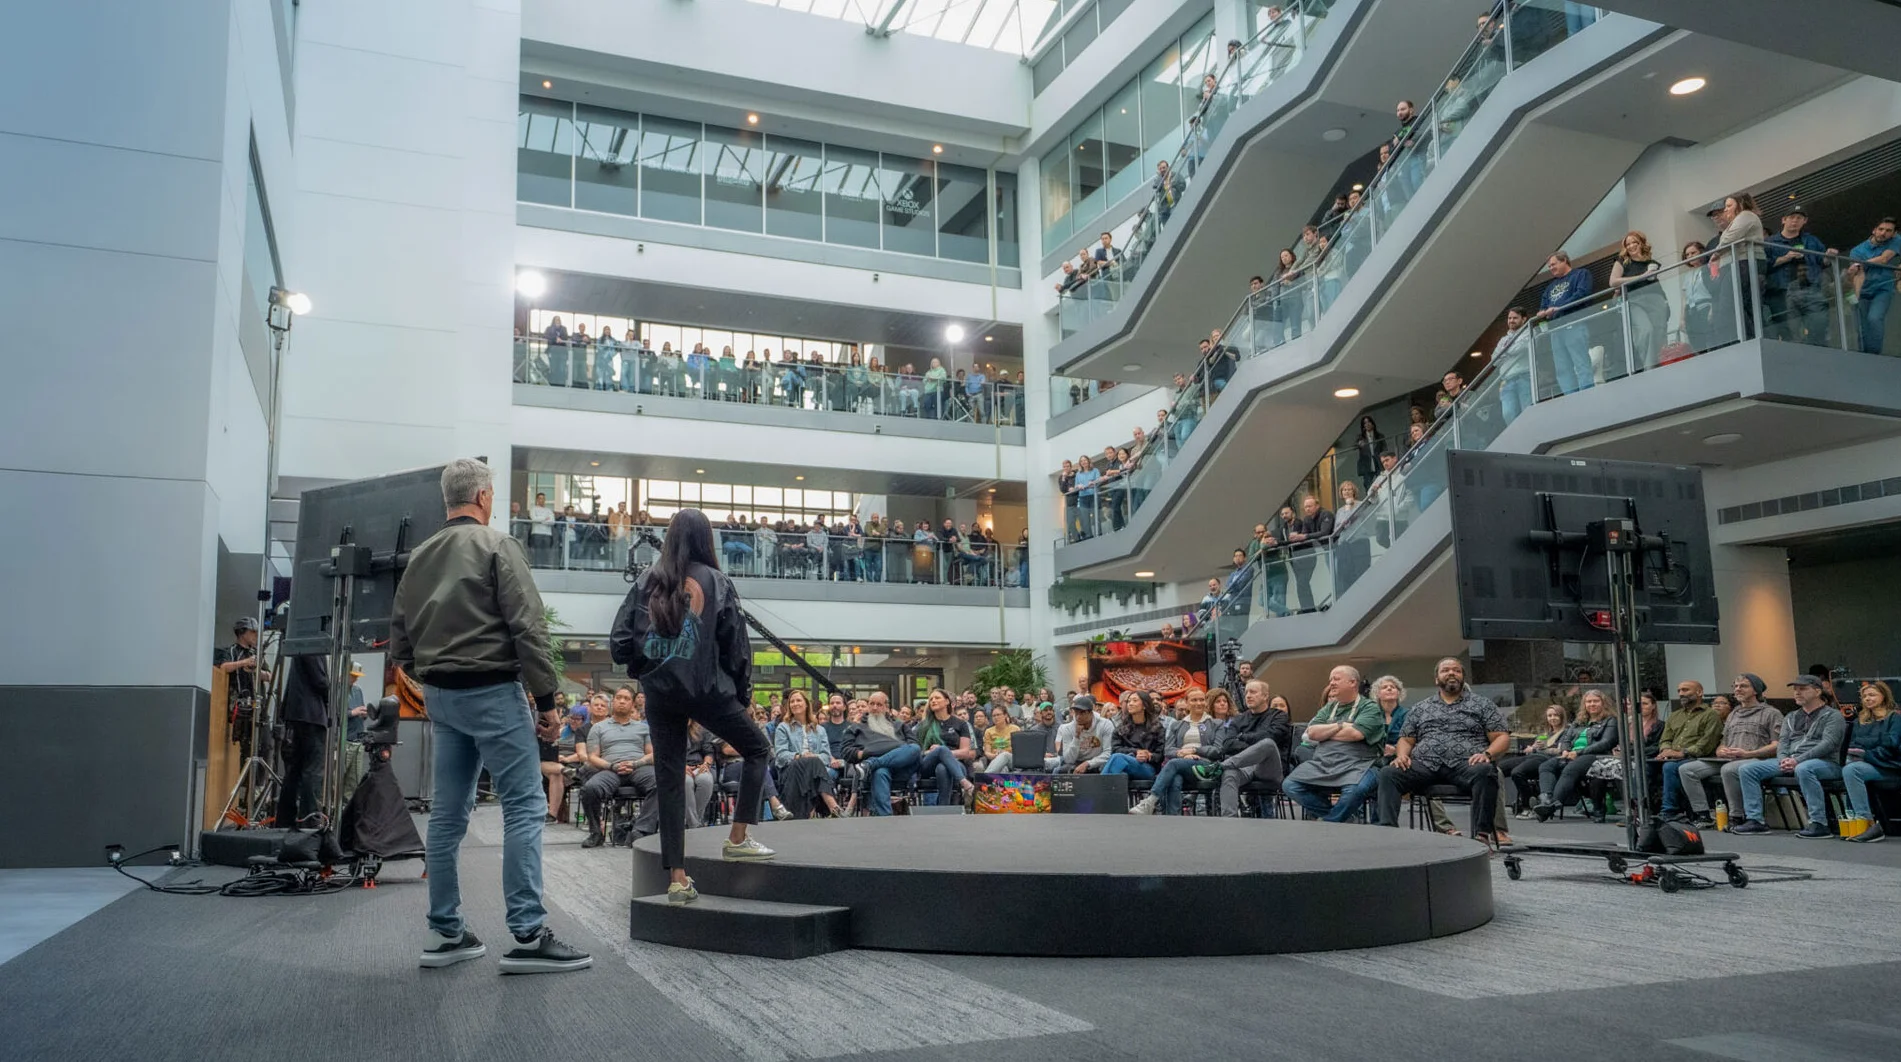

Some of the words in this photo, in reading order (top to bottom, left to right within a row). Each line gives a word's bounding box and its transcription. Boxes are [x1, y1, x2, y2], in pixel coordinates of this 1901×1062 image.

[896, 199, 919, 209] XBOX
[886, 205, 903, 213] GAME
[905, 208, 930, 217] STUDIOS
